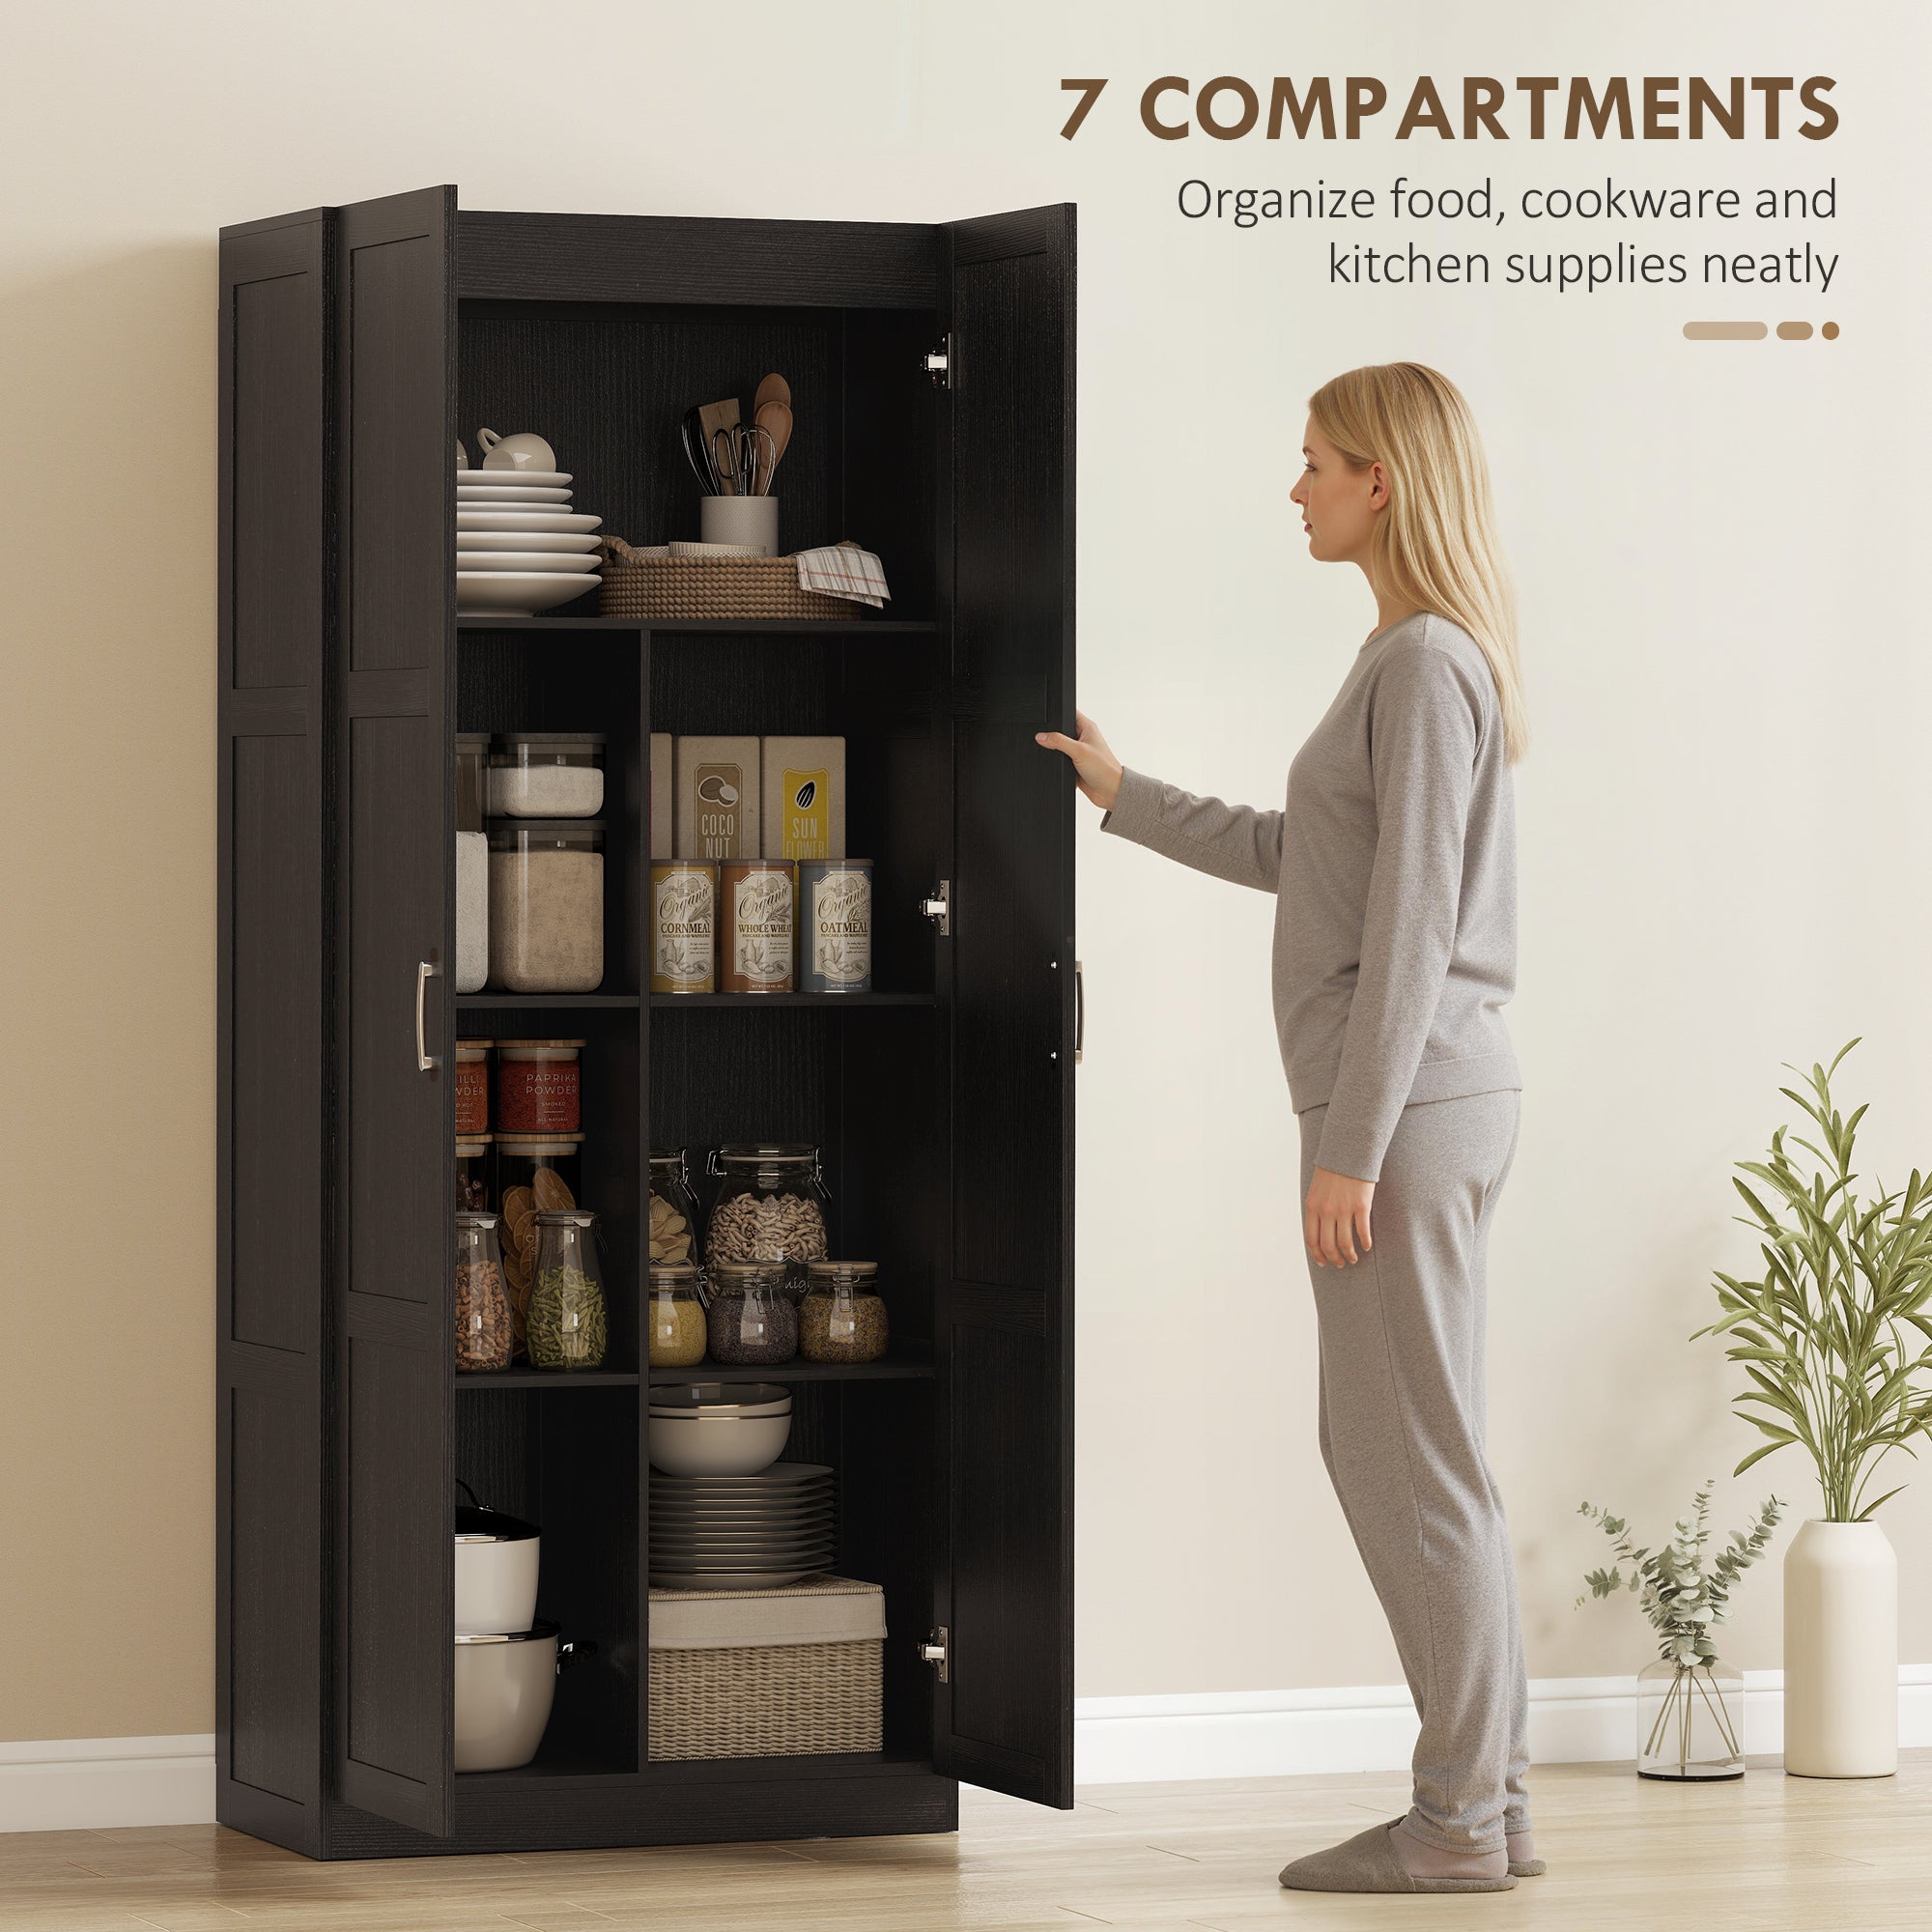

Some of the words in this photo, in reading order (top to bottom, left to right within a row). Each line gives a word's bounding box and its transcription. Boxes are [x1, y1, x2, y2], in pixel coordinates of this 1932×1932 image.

[701, 813, 734, 836] COCO
[792, 817, 818, 838] SUN
[705, 838, 730, 859] NUT
[785, 840, 825, 859] FLOWER
[661, 923, 711, 934] CORNMEAL
[738, 923, 769, 933] WHOLE
[770, 923, 792, 933] WHEAT
[820, 922, 868, 933] OATMEAL
[459, 1073, 480, 1084] ILLI
[526, 1073, 577, 1083] PAPRIKA
[456, 1087, 484, 1096] WDER
[526, 1086, 578, 1095] POWDER
